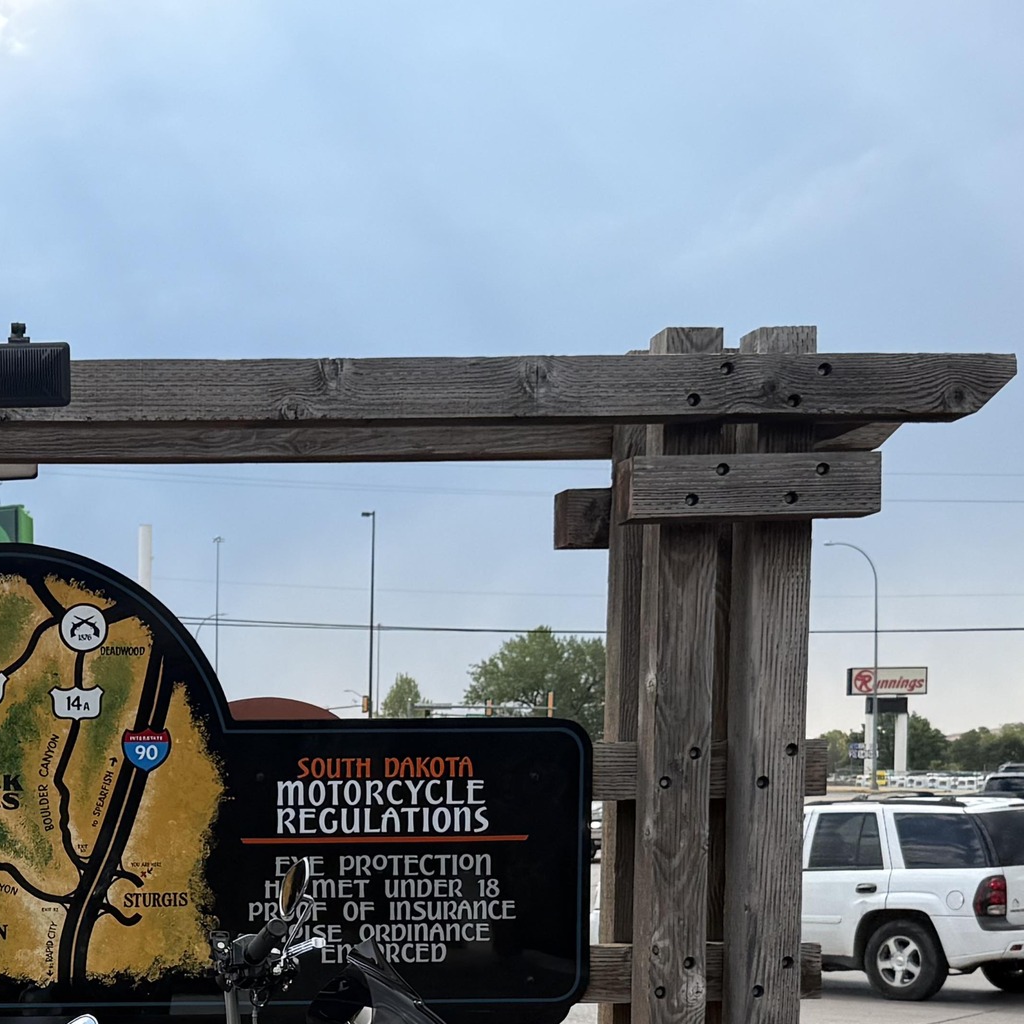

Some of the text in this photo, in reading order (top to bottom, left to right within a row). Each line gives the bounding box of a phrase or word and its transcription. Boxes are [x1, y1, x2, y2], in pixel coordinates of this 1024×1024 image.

[100, 646, 146, 656] DEADWOOD
[135, 744, 158, 760] 90
[297, 756, 474, 779] SOUTH DAKOTA
[38, 734, 60, 832] BOULDER CANYON
[93, 770, 114, 817] SPEARFISH
[277, 780, 486, 806] MOTORCYCLE
[277, 806, 489, 834] REGULATIONS
[339, 854, 491, 876] PROTECTION
[265, 878, 500, 899] HMET UNDER 18
[123, 892, 188, 908] STURGIS
[343, 901, 375, 921] OF
[390, 900, 516, 920] INSURANCE
[48, 921, 58, 939] CITY
[281, 923, 490, 942] OISE ORDINANCE
[45, 940, 54, 962] RAPID
[321, 943, 447, 963] ENRCED
